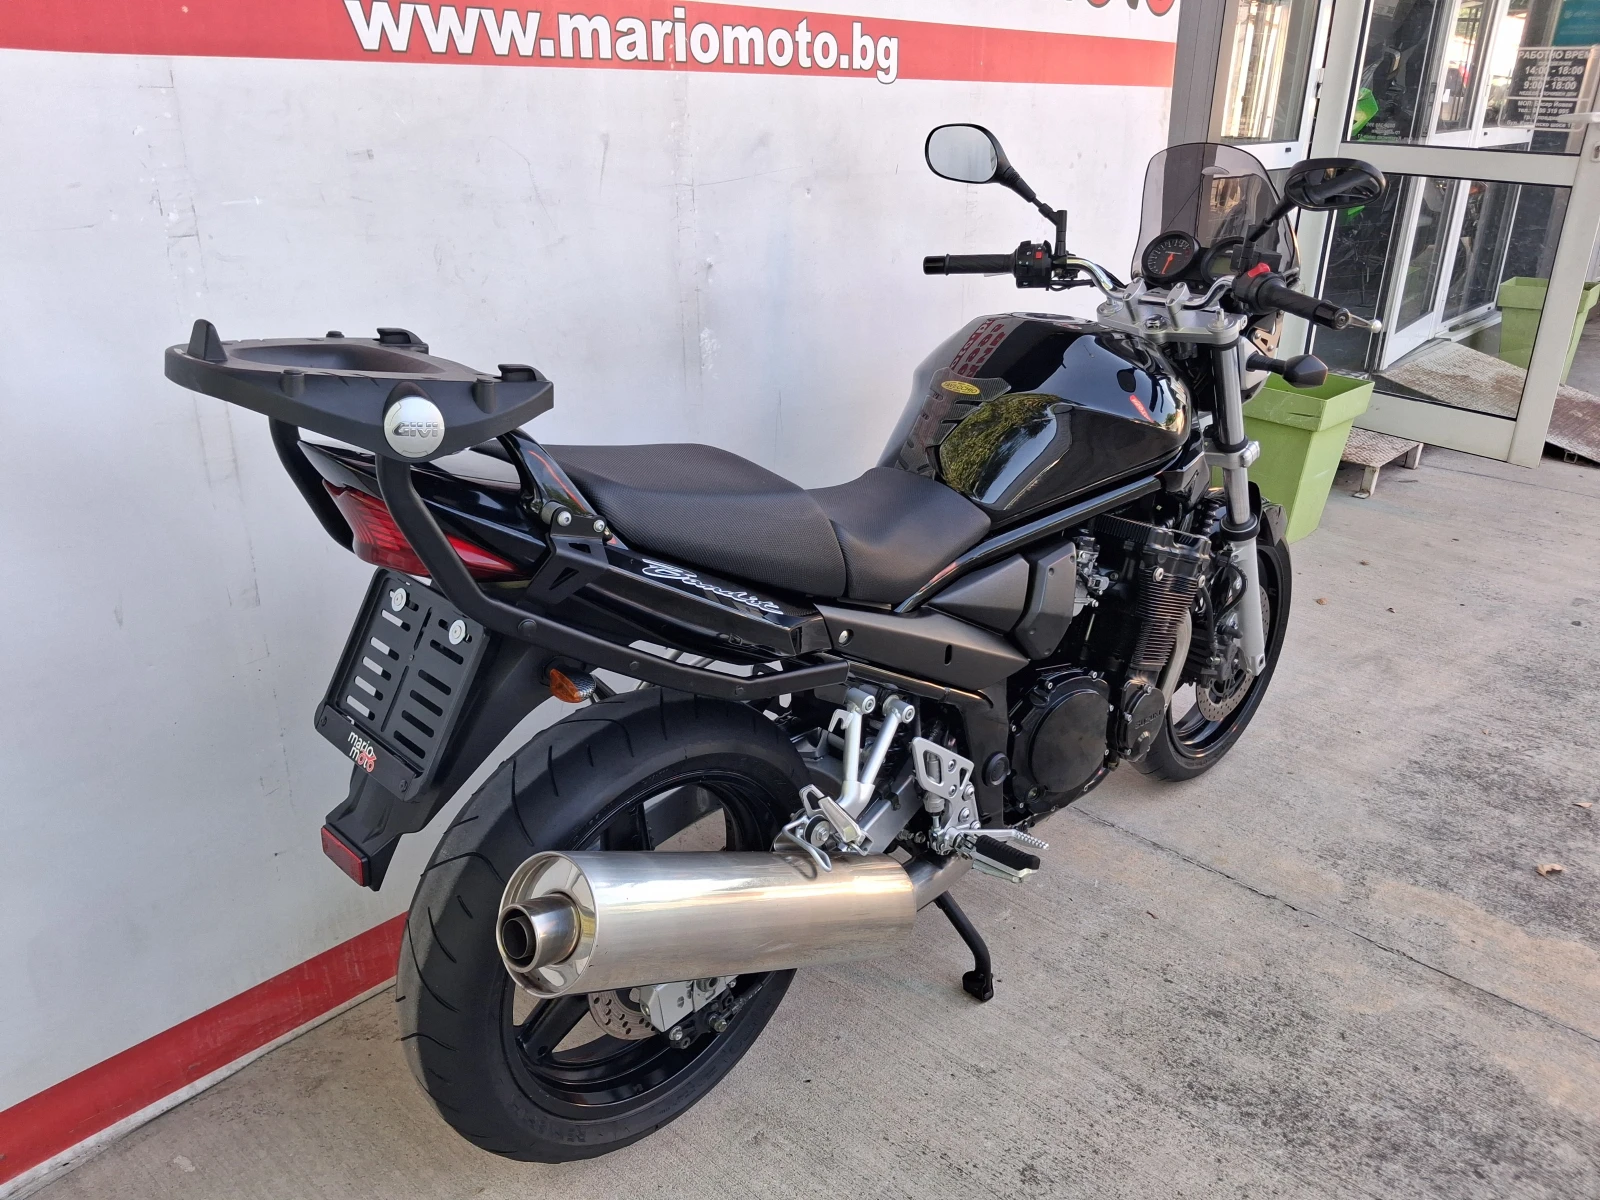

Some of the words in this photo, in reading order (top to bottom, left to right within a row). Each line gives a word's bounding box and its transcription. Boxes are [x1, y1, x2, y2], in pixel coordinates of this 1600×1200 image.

[341, 0, 898, 84] www.mariomoto.bg
[1517, 50, 1563, 60] РАБОТНО
[1525, 66, 1549, 75] 14:00
[1558, 66, 1584, 75] 18:00
[1523, 81, 1543, 89] 9:00
[1551, 81, 1577, 90] 18:00
[391, 421, 439, 438] GIVI
[347, 731, 374, 757] mario
[349, 746, 376, 772] moto
